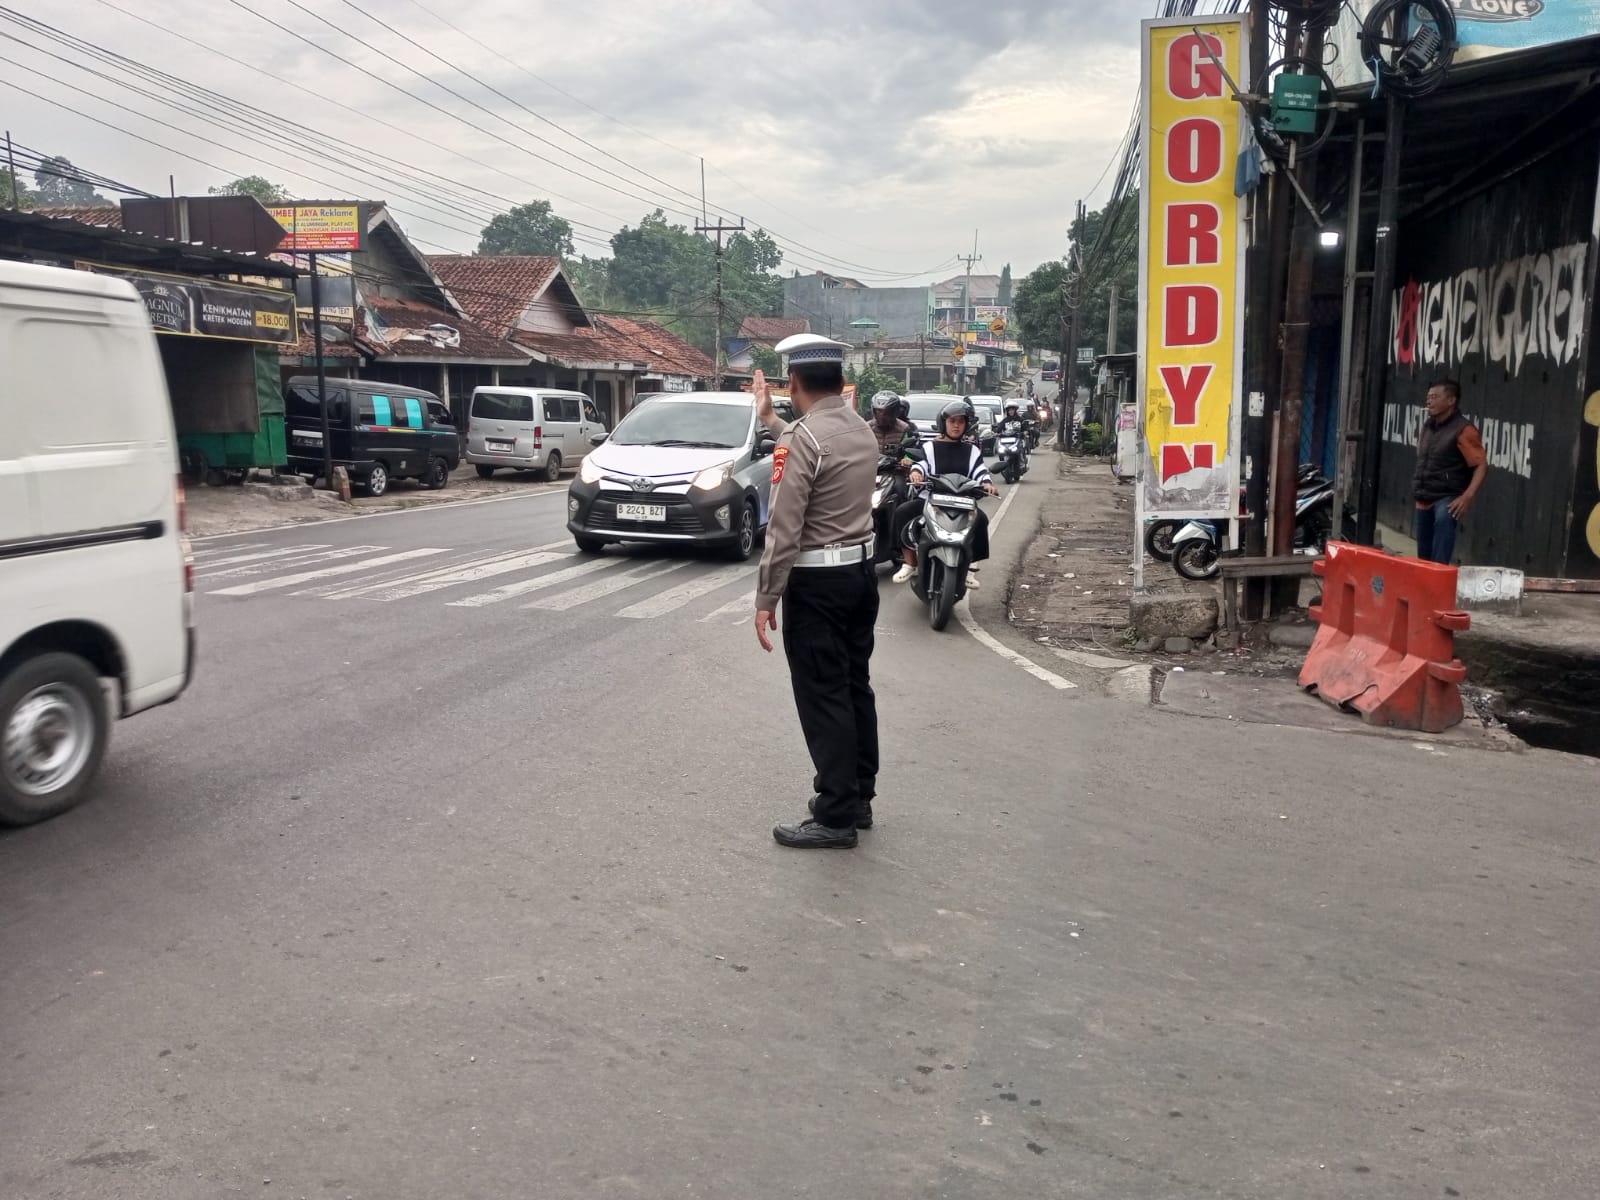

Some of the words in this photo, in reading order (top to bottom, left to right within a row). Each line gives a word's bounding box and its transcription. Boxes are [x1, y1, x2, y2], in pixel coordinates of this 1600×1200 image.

[299, 208, 318, 217] JAYA
[320, 208, 353, 217] Reklame
[1160, 33, 1224, 485] GORDYN
[202, 303, 251, 318] KENIKMATAN
[150, 312, 178, 327] RETEK
[202, 313, 225, 323] KRETEK
[227, 317, 252, 326] MODERN
[262, 313, 289, 328] 18.000
[1482, 417, 1534, 479] ALONE
[618, 504, 624, 514] B
[626, 505, 646, 515] 2241
[649, 506, 665, 516] BZT
